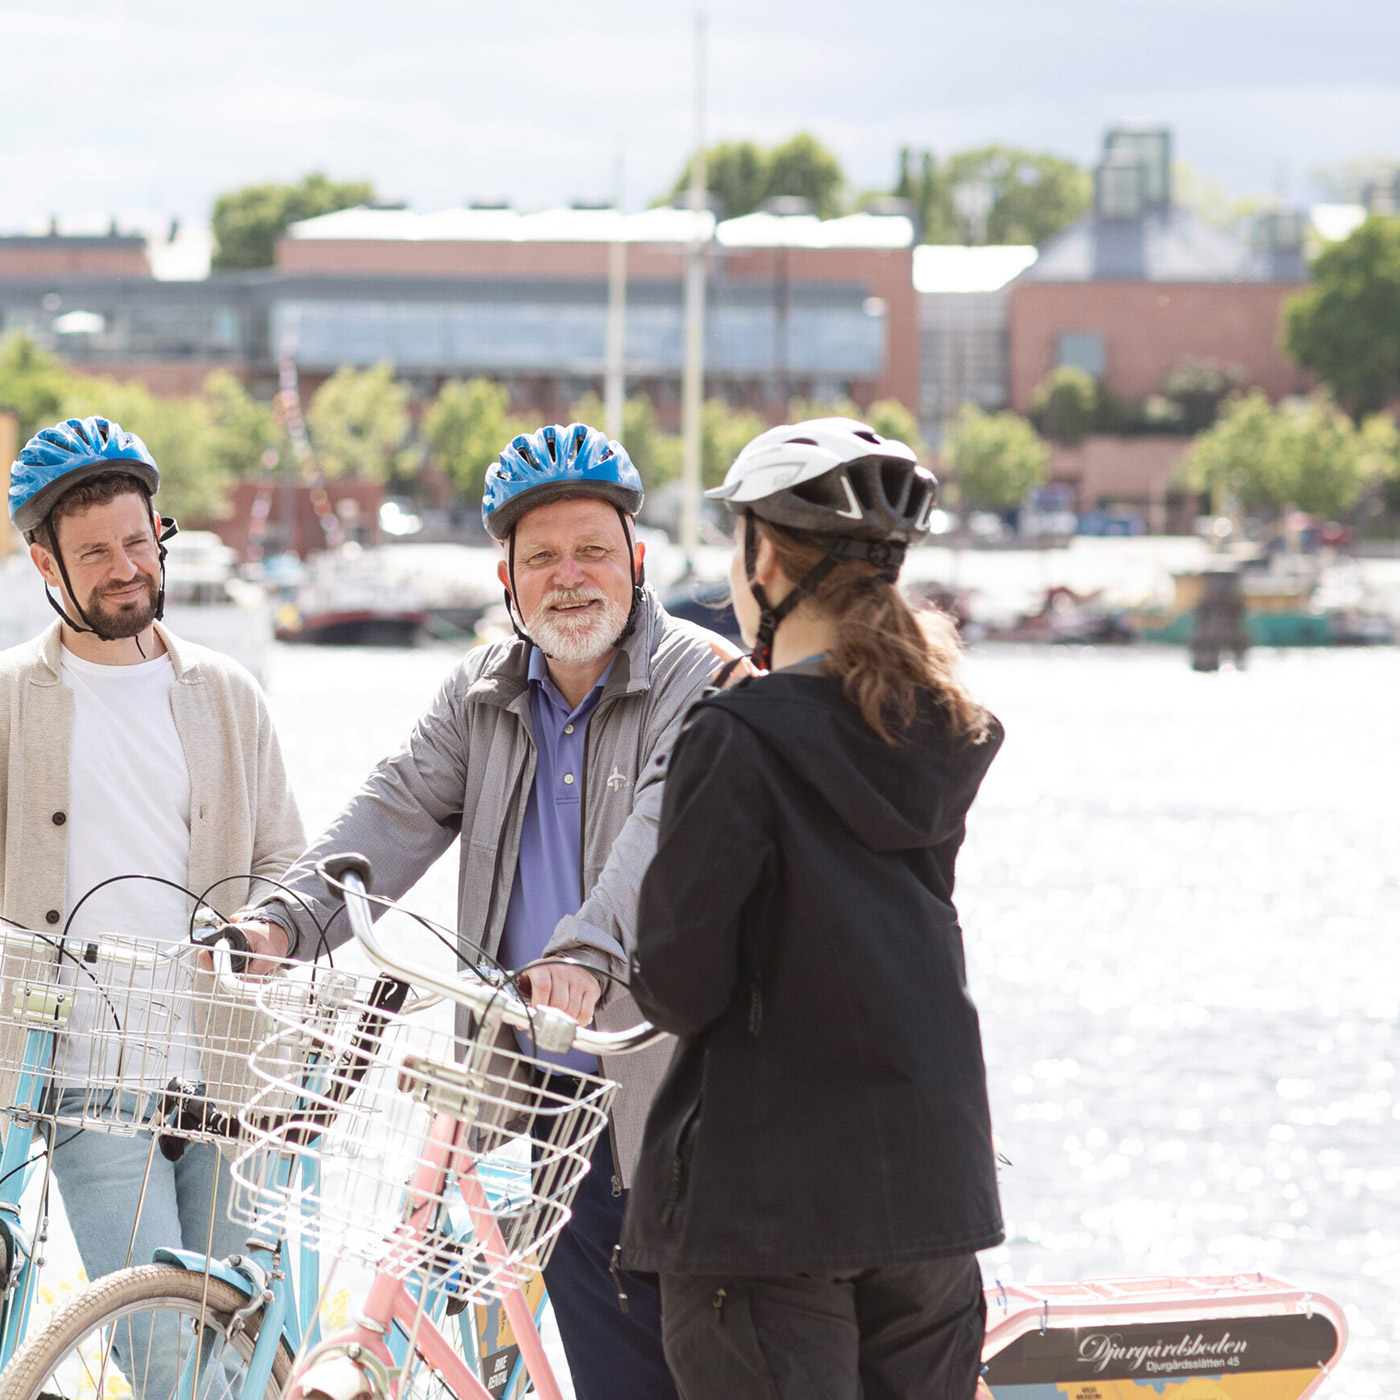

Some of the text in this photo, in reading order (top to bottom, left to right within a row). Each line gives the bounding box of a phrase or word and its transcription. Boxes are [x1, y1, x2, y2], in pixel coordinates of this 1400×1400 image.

[1076, 1331, 1247, 1373] Djurgårdsboden
[1226, 1355, 1240, 1367] 45
[494, 1354, 508, 1373] BIKE
[487, 1369, 508, 1389] RENTAL
